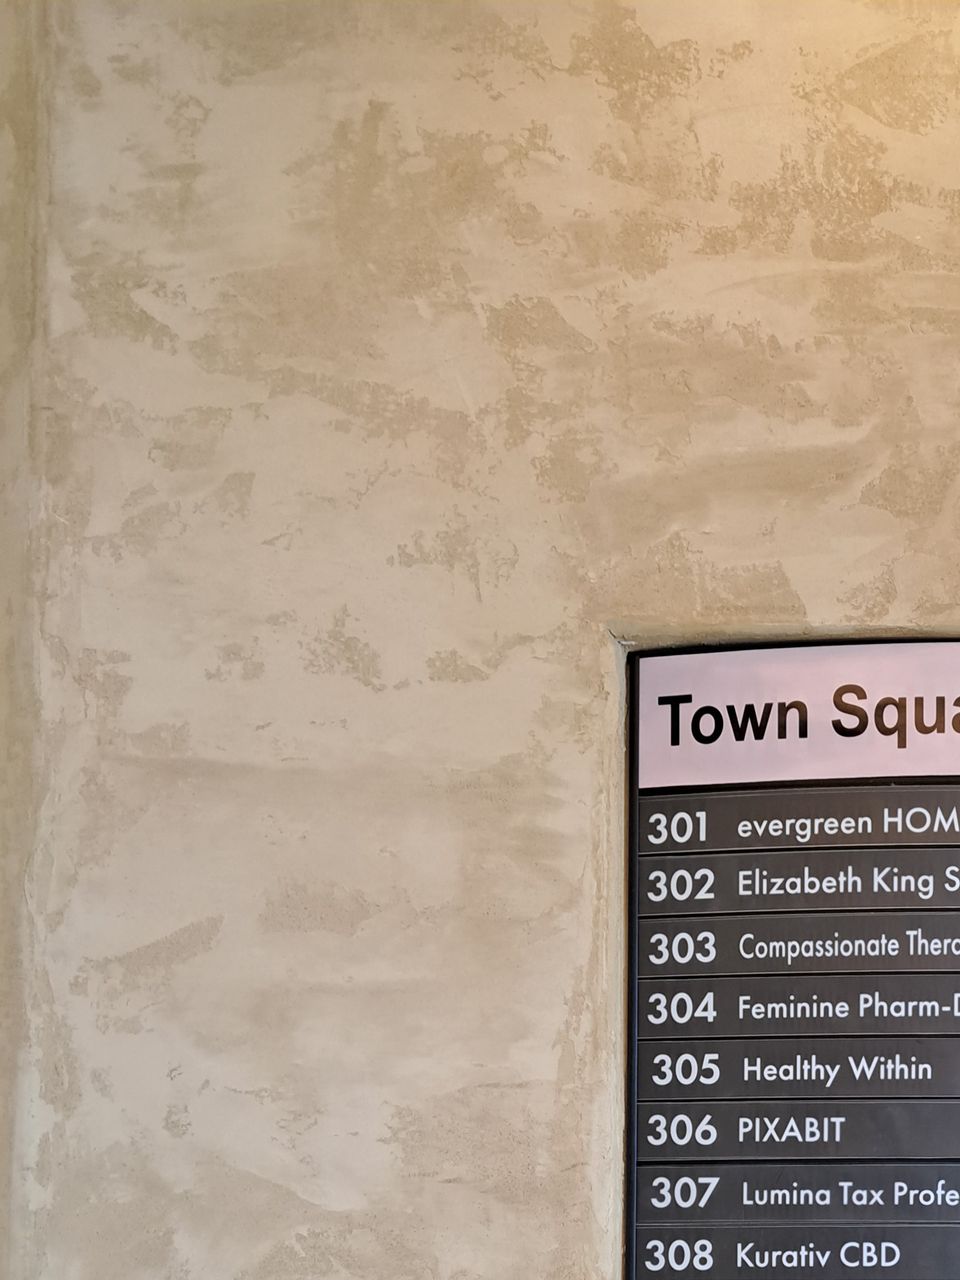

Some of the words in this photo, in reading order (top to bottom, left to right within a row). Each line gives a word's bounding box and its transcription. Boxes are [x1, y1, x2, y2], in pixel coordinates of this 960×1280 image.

[657, 693, 809, 747] Town
[647, 810, 707, 845] 301
[737, 816, 873, 844] evergreen
[646, 867, 715, 903] 302
[738, 865, 863, 896] Elizabeth
[872, 866, 935, 901] King
[648, 930, 717, 966] 303
[738, 931, 900, 966] Compassionate
[646, 991, 718, 1026] 304
[738, 994, 850, 1020] Feminine
[651, 1052, 721, 1087] 305
[743, 1054, 841, 1088] Healthy
[847, 1053, 933, 1081] Within
[646, 1113, 718, 1147] 306
[738, 1116, 847, 1143] PIXABIT
[649, 1176, 721, 1209] 307
[742, 1181, 831, 1206] Lumina
[837, 1181, 886, 1206] Tax
[644, 1238, 714, 1272] 308
[736, 1242, 832, 1269] Kurativ
[839, 1241, 901, 1268] CBD
